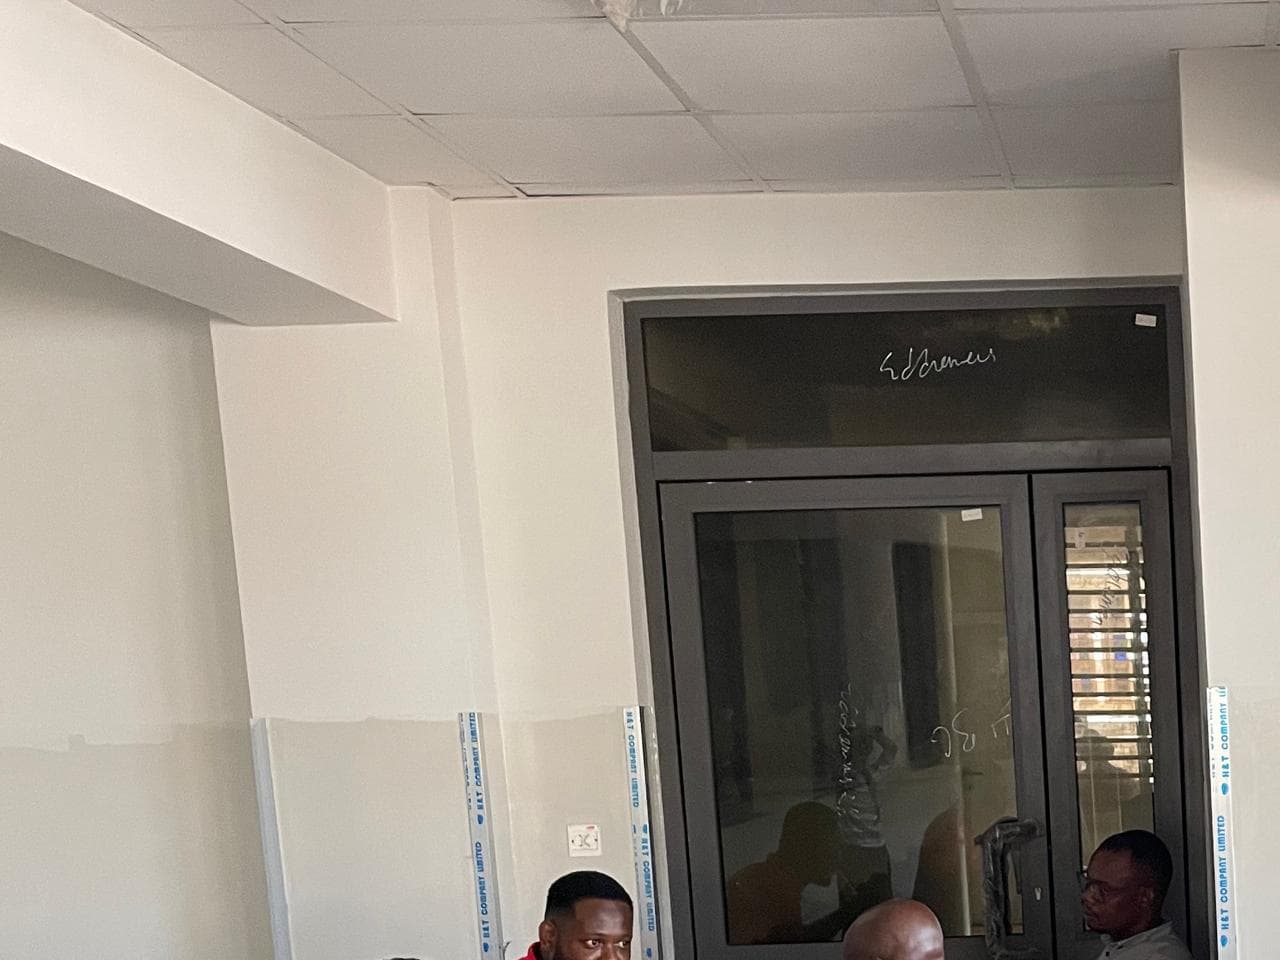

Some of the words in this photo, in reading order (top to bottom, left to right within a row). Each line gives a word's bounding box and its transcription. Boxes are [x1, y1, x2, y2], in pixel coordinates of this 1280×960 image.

[1219, 703, 1229, 750] COMPANY
[1216, 815, 1226, 852] LIMITED
[1218, 856, 1229, 903] COMPANY
